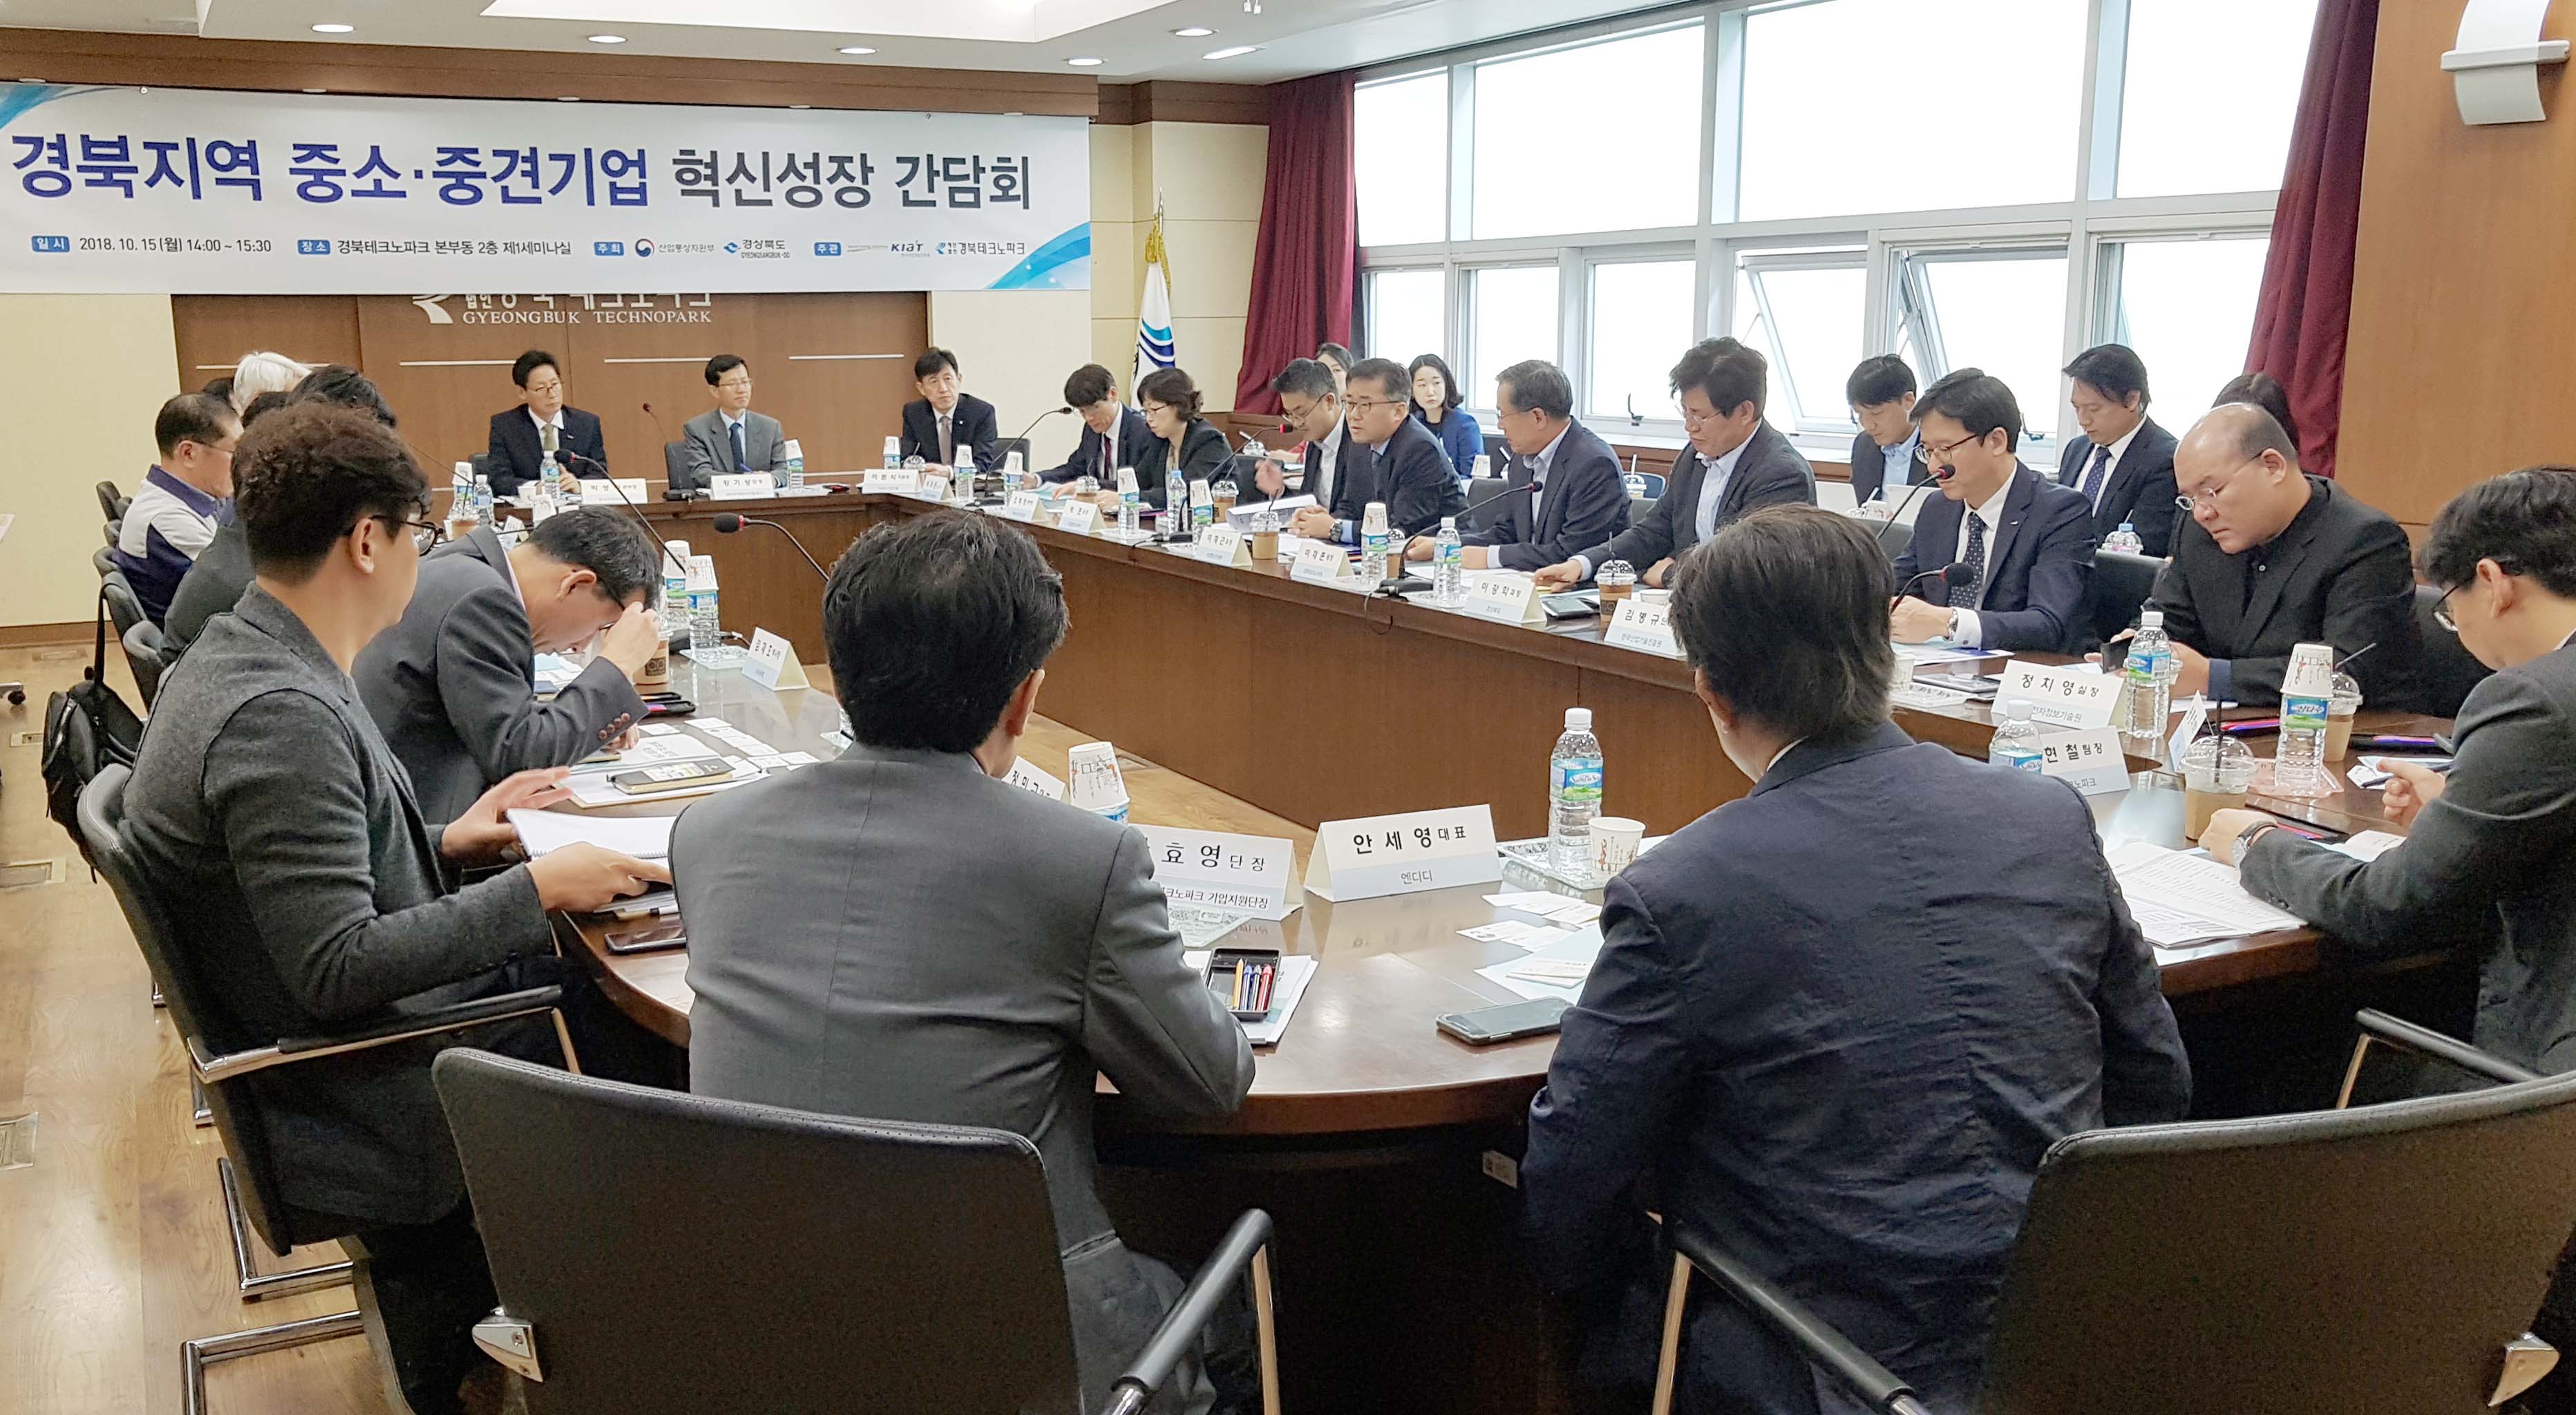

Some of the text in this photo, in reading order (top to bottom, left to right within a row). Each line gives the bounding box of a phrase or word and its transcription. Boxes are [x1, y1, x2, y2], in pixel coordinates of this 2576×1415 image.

[11, 132, 1030, 210] 경북지역 중소·중견기업 혁신성장 간담회
[36, 236, 66, 251] 일시
[79, 238, 115, 251] 2018.
[118, 238, 138, 251] 10.
[187, 239, 221, 252] 14:00
[237, 240, 272, 253] 15:30
[301, 240, 328, 252] 장소
[337, 240, 572, 256] 경북테크노파크 본부동 2층 제1세미나실
[742, 239, 786, 249] 경상북도
[817, 243, 840, 254] 주관
[959, 242, 1025, 255] 경북테크노파크
[462, 310, 712, 324] GYEONGBUK TECHNOPARK
[2021, 674, 2100, 698] 정치영 실장
[1353, 826, 1466, 855] 안세영 대표
[1145, 837, 1266, 872] 효영 단장
[1401, 868, 1433, 885] 엔디디
